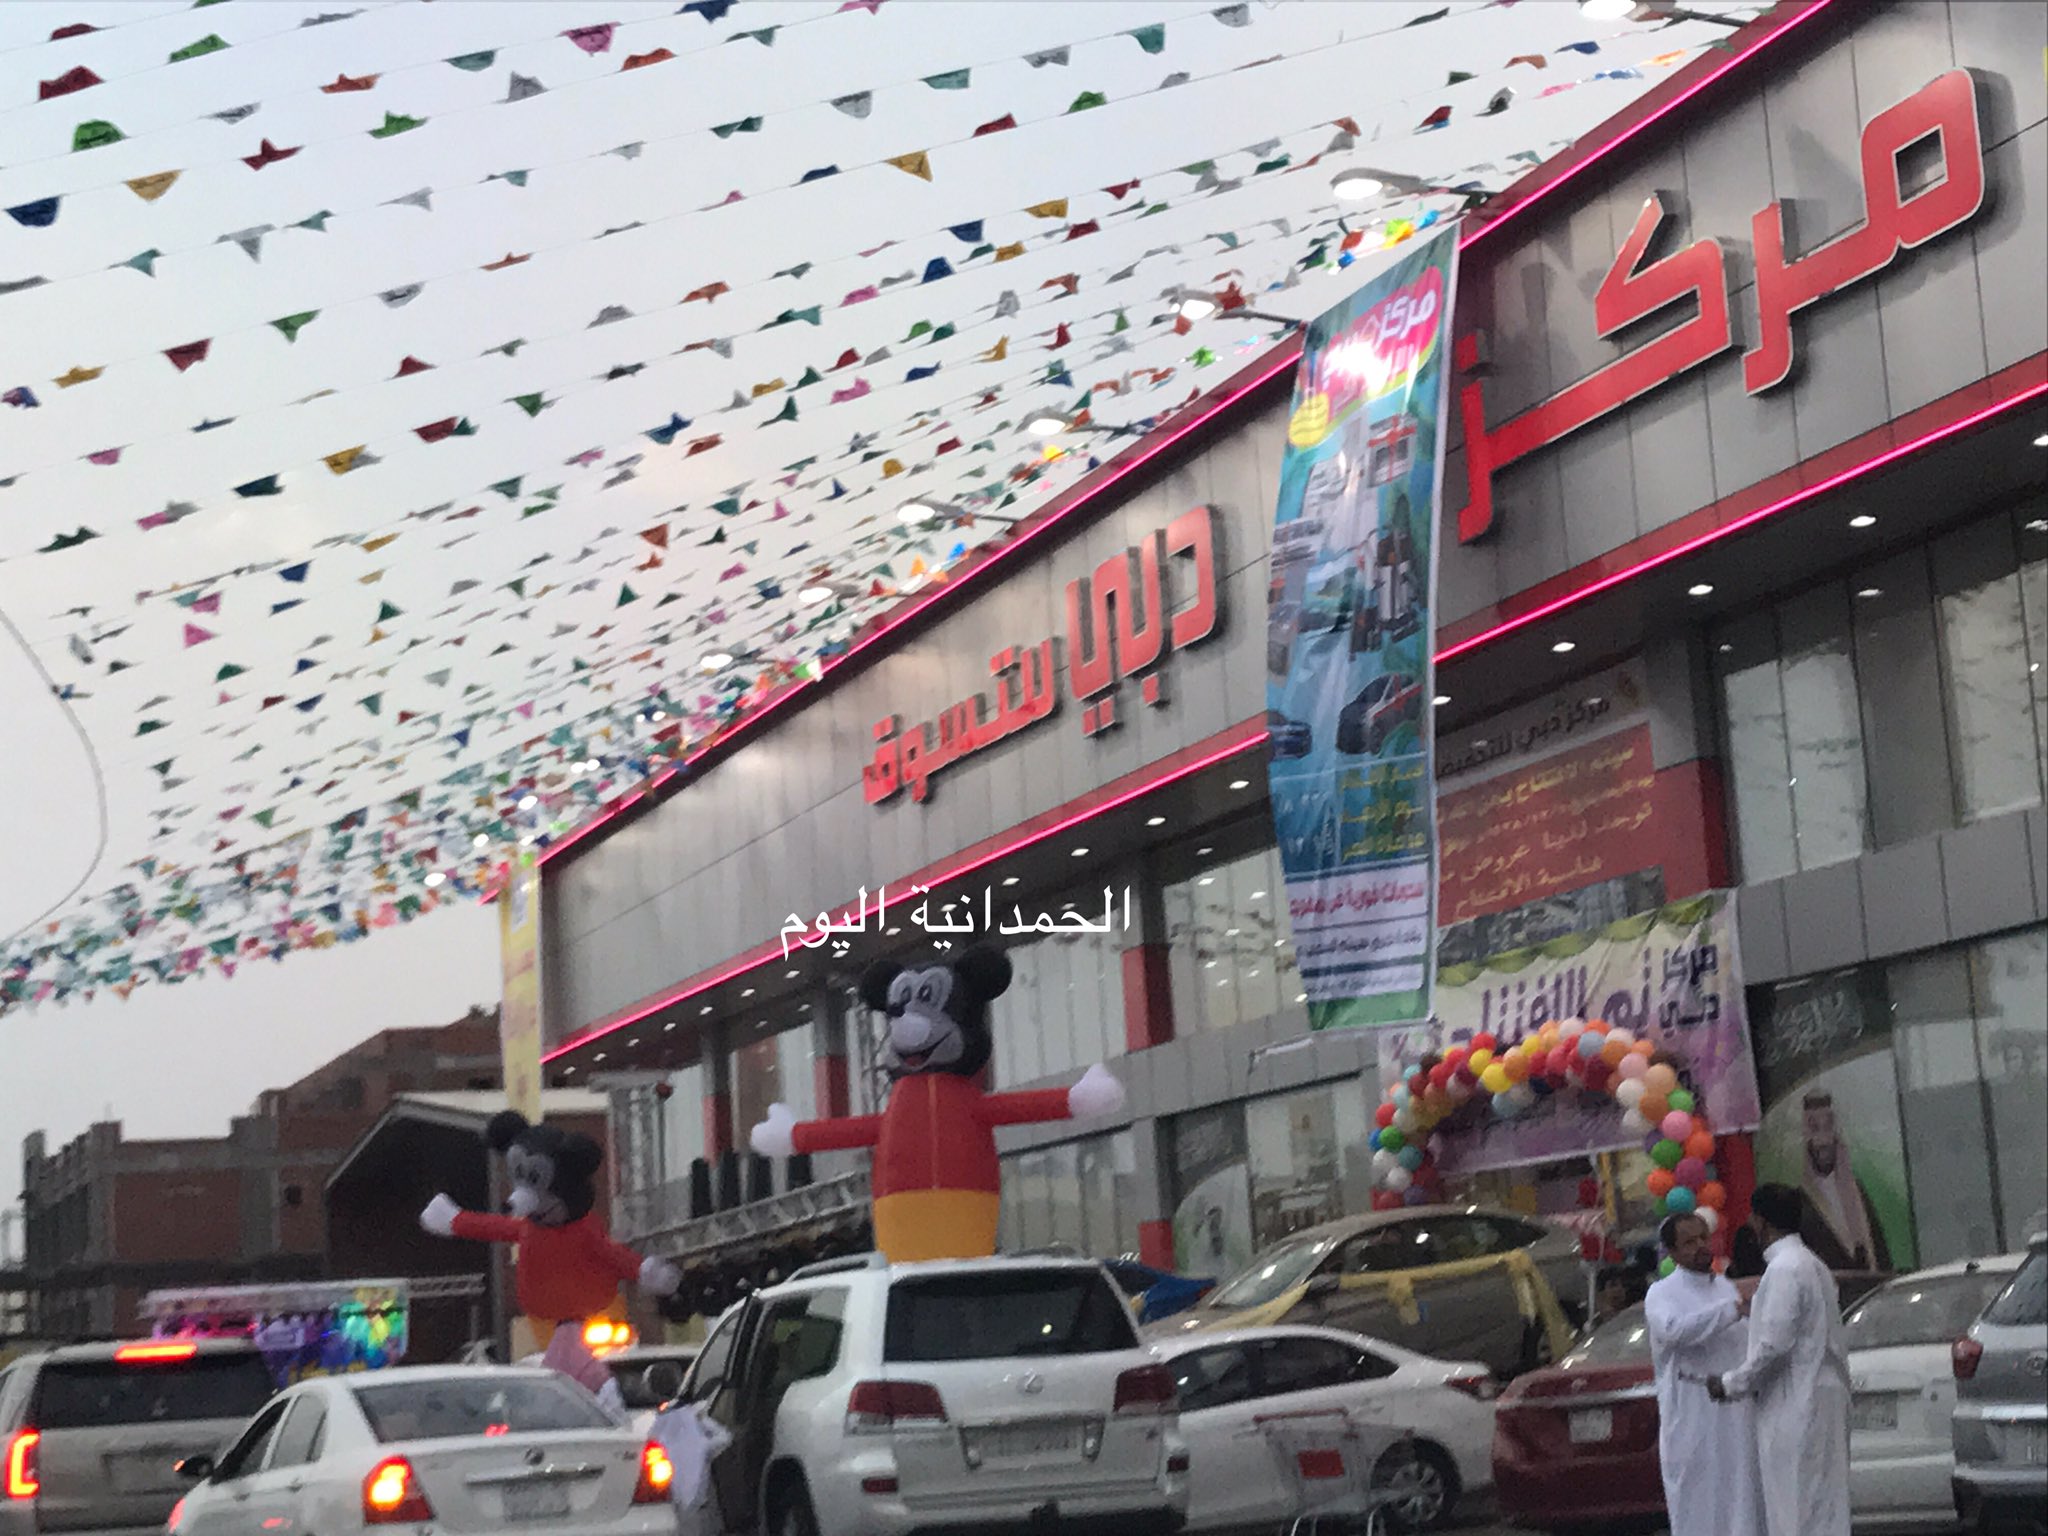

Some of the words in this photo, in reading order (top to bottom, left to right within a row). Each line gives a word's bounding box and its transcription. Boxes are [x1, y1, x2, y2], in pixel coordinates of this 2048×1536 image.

[1375, 289, 1437, 350] مركز
[1457, 67, 1984, 545] مركز
[1066, 504, 1217, 736] دبي
[862, 638, 1056, 805] للتسوق
